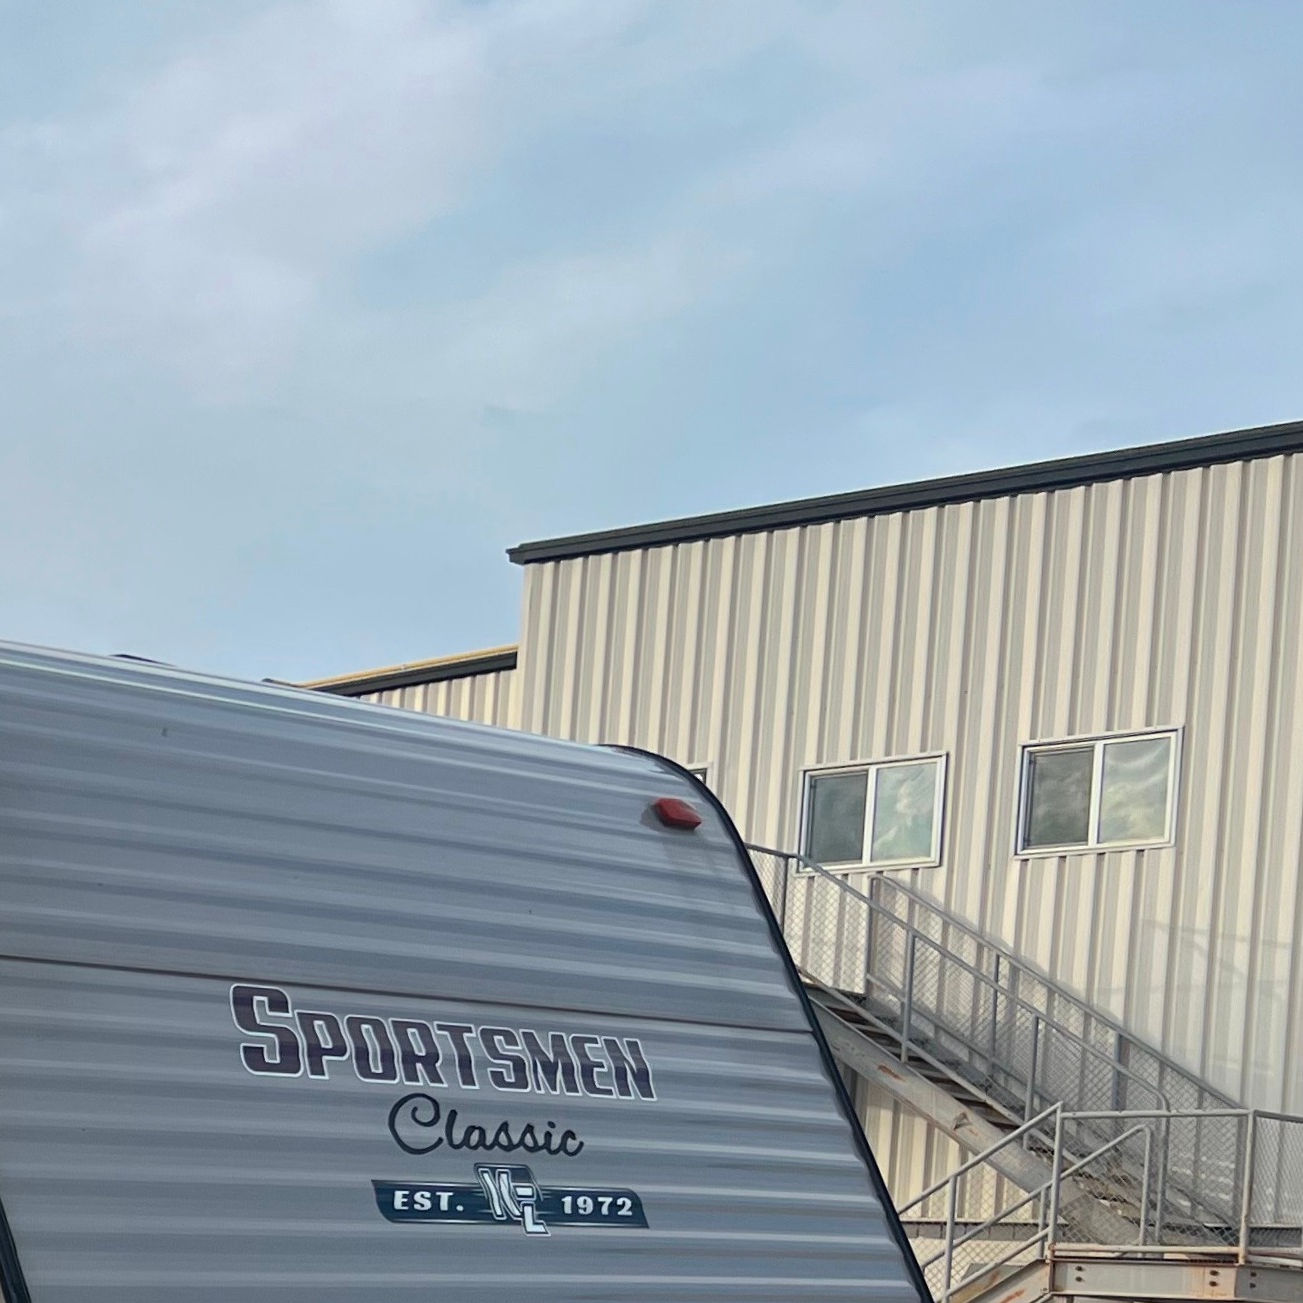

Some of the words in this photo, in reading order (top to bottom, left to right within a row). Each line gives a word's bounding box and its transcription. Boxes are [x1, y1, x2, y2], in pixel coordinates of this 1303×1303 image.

[229, 984, 657, 1100] SPORTSMEN
[388, 1093, 584, 1156] Classic
[393, 1190, 464, 1212] EST.
[561, 1195, 633, 1217] 1972
